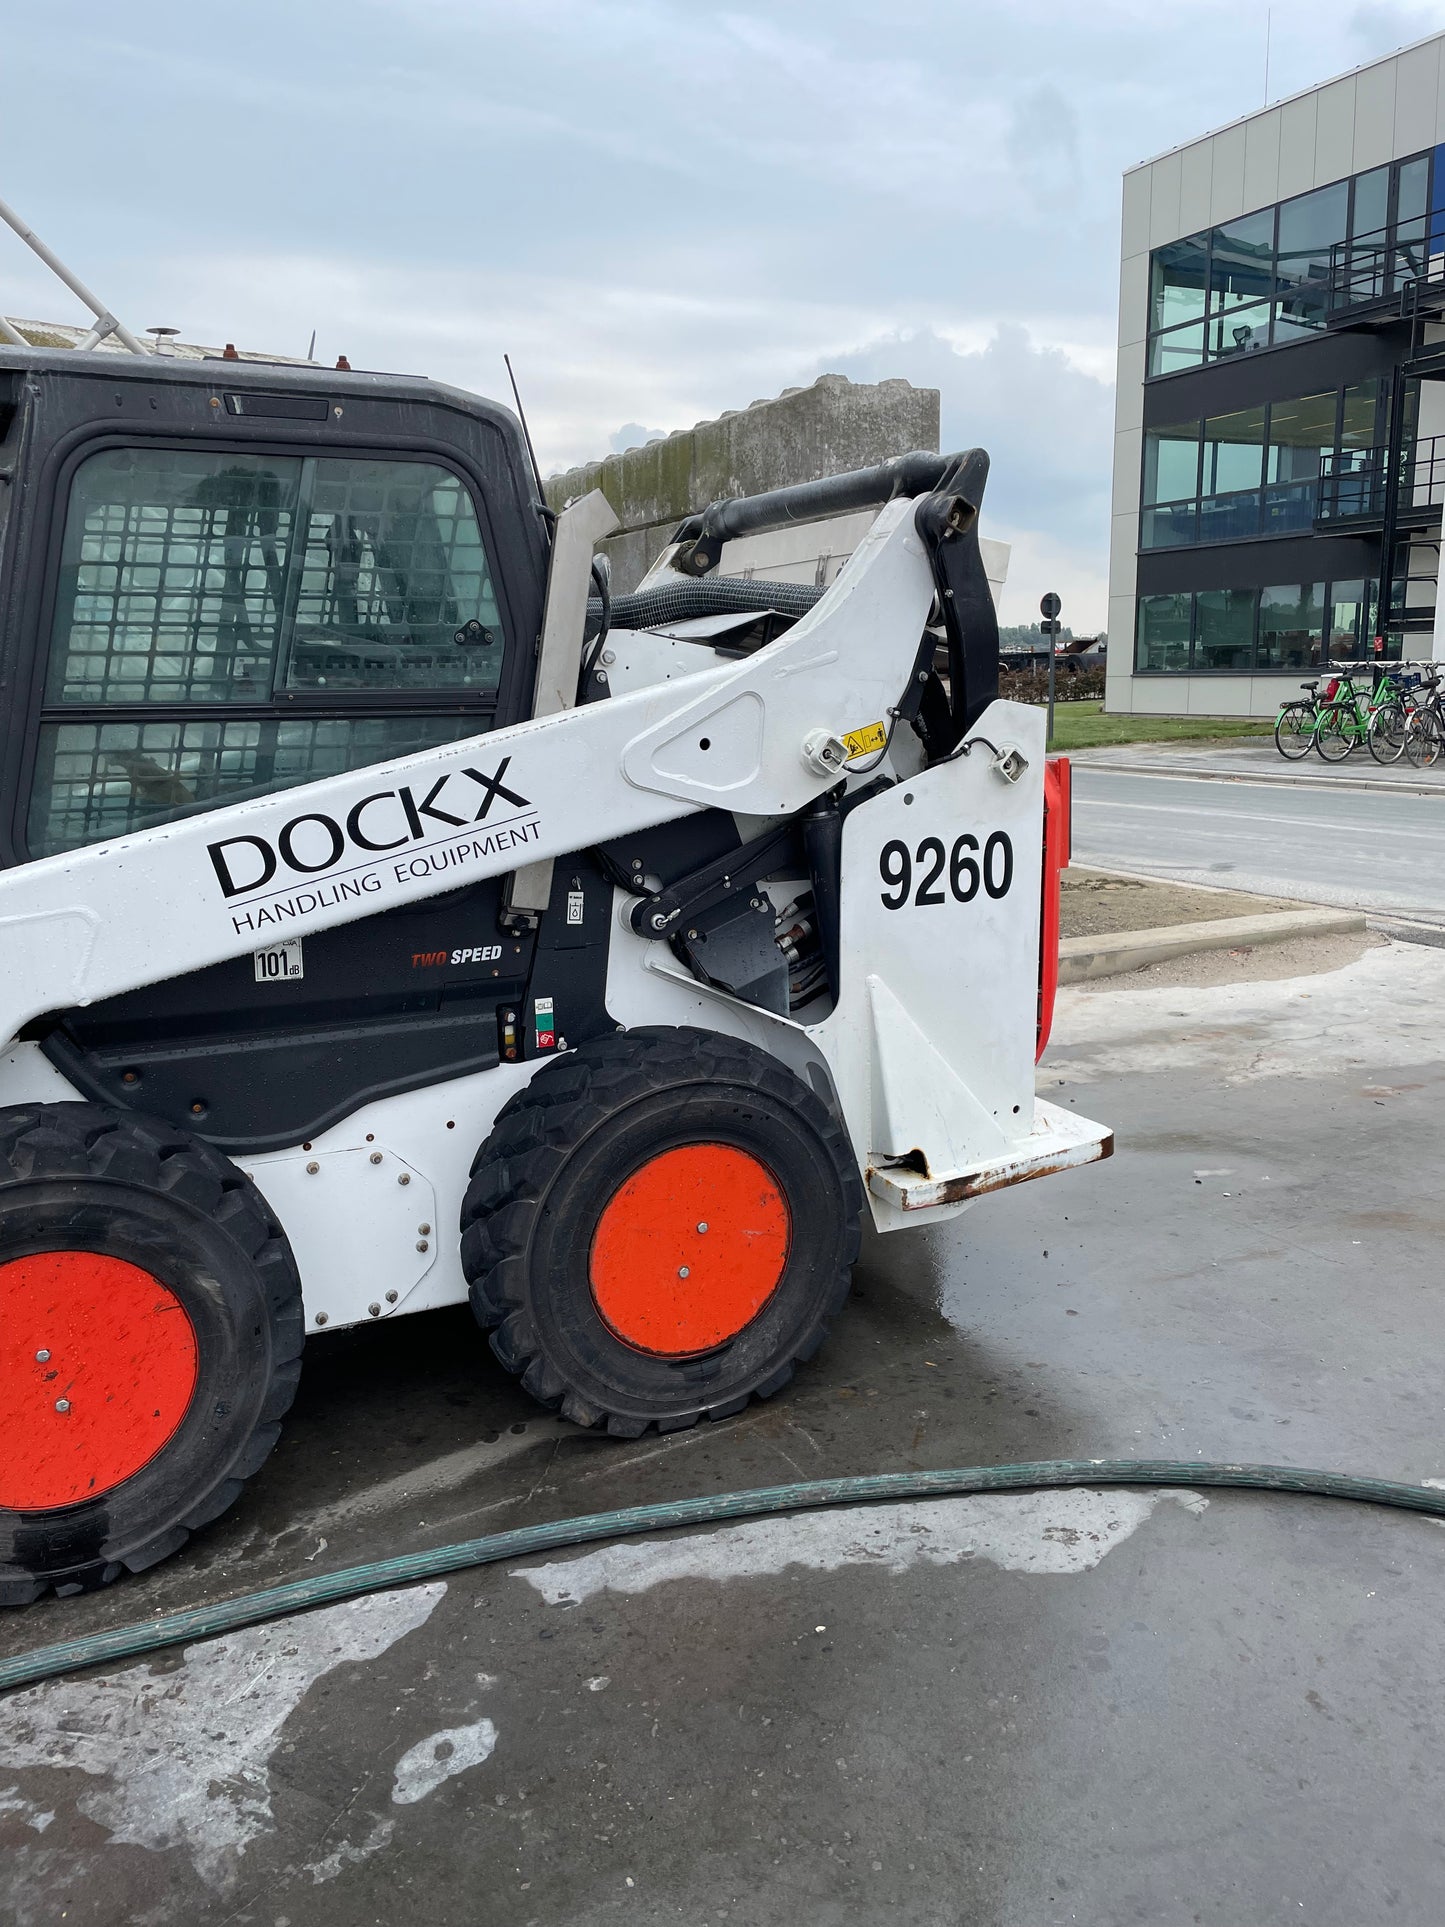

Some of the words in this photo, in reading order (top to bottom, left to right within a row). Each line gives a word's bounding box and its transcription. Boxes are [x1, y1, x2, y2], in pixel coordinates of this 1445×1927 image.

[206, 755, 532, 898] DOCKX
[231, 873, 382, 935] HANDLING
[393, 820, 542, 883] EQUIPMENT
[879, 830, 1014, 911] 9260
[257, 948, 289, 978] 101
[289, 964, 300, 976] dB
[411, 951, 447, 968] TWO
[450, 945, 503, 965] SPEED
